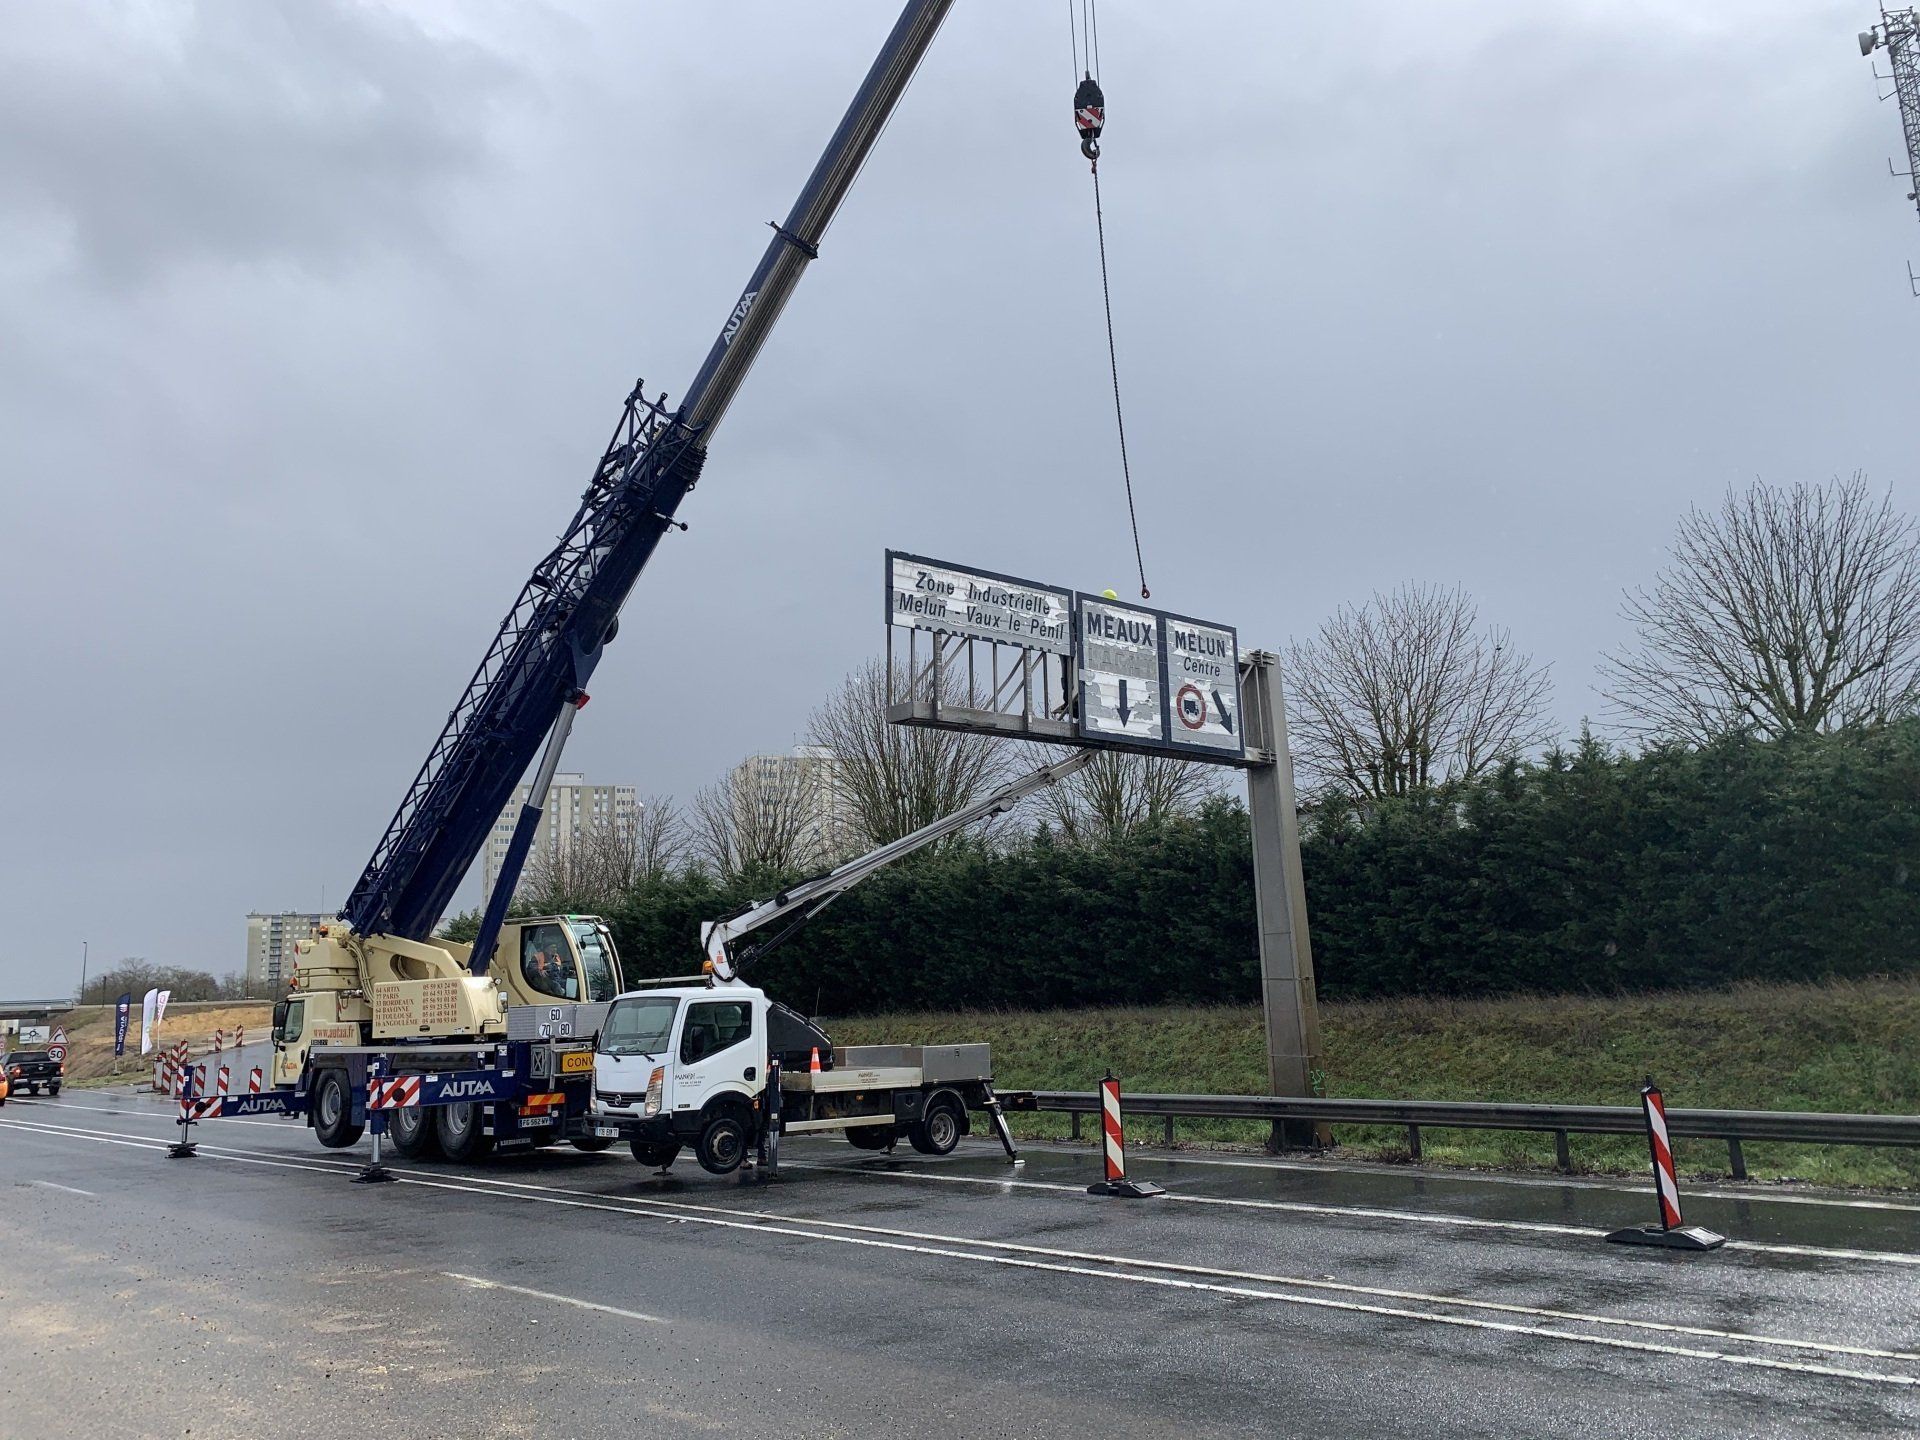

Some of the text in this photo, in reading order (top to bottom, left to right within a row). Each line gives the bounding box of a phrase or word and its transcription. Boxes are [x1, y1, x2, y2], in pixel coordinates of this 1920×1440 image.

[722, 291, 758, 346] AUTAA
[915, 571, 1050, 615] Zone Industrielle
[899, 592, 946, 618] Melun
[966, 605, 1001, 629] Vaux
[1008, 614, 1021, 632] le
[1087, 611, 1153, 647] MEAUX
[1174, 630, 1226, 658] MELUN
[1183, 656, 1221, 677] Centre
[382, 1012, 413, 1020] TOULOUSE
[550, 1009, 561, 1021] 60
[541, 1025, 551, 1037] 70
[560, 1024, 570, 1036] 80
[50, 1050, 63, 1059] 50
[439, 1080, 495, 1098] AUTAA
[237, 1098, 286, 1113] AUTAA
